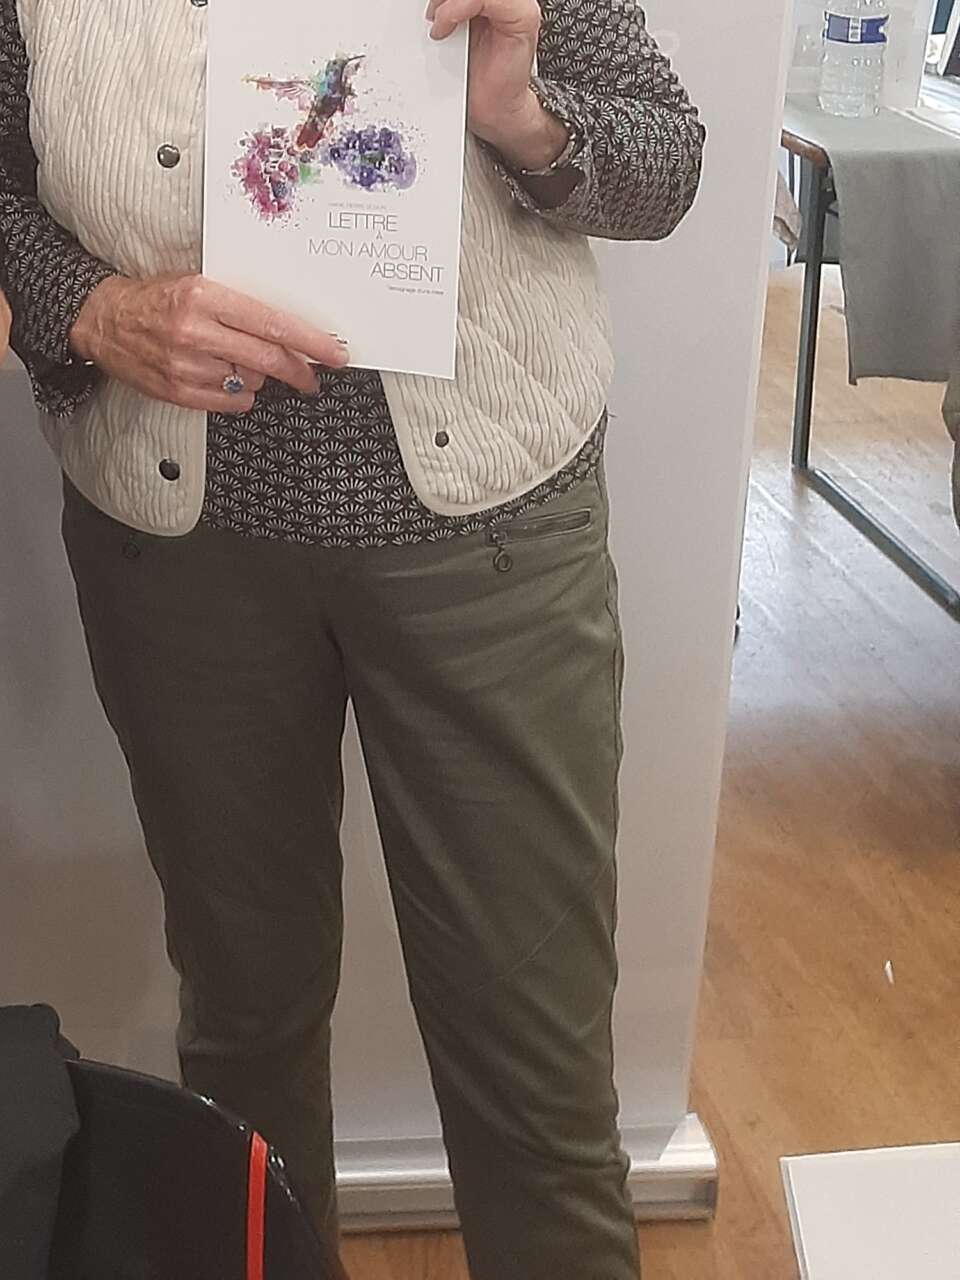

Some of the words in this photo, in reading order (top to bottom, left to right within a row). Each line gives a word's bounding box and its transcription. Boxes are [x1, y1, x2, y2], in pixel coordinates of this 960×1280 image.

[328, 211, 399, 233] LETTRE
[309, 238, 353, 257] MON
[358, 241, 428, 262] AMOUR
[370, 261, 445, 283] ABSENT
